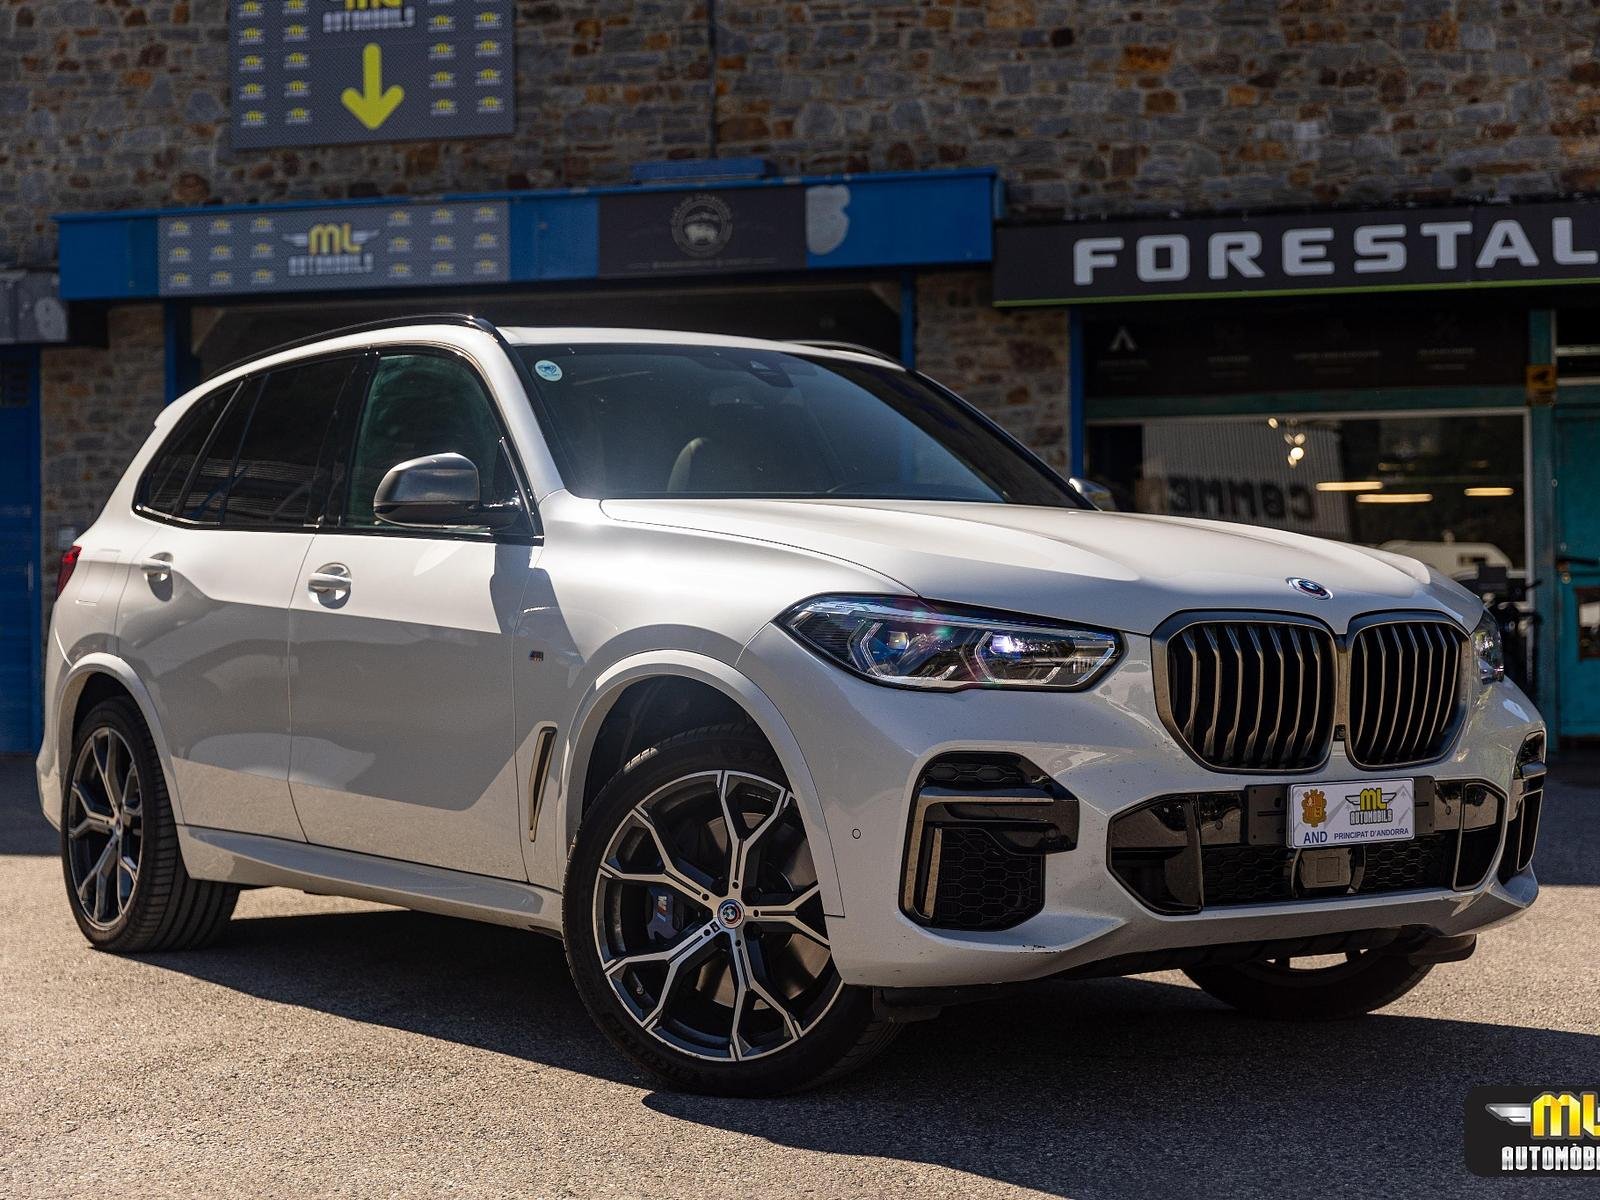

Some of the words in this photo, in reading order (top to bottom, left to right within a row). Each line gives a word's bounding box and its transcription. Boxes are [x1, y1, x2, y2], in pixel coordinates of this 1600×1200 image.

[308, 223, 362, 255] ML
[1073, 217, 1599, 285] FORESTAL
[1359, 787, 1388, 810] ML
[1303, 831, 1328, 844] AND
[1333, 831, 1369, 840] PRINCIPAT
[1370, 827, 1409, 838] D'ANDORRA
